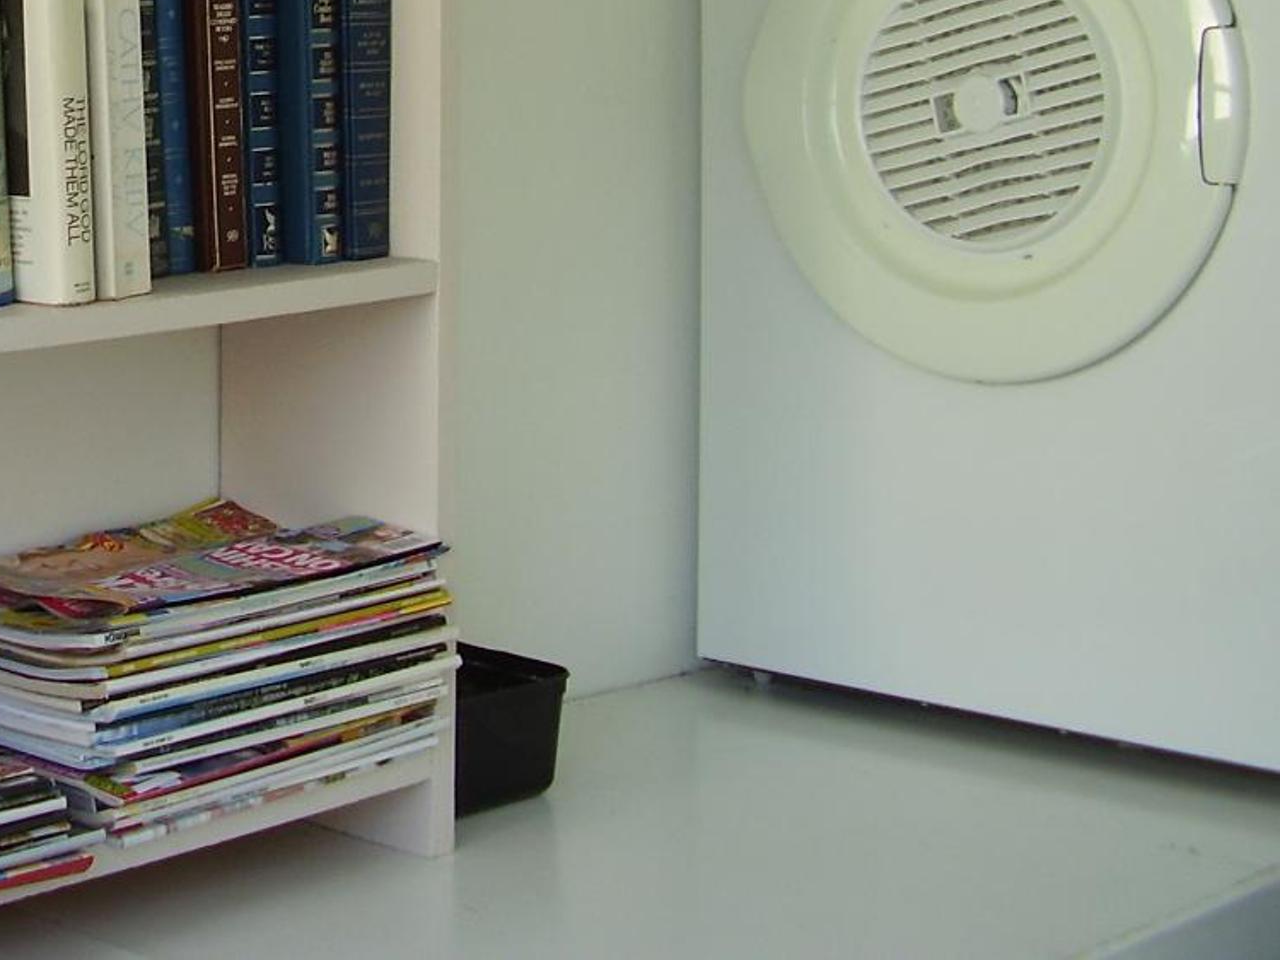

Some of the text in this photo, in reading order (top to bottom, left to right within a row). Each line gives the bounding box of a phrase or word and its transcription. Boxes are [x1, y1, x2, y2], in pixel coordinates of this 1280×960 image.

[113, 7, 146, 134] CATHY
[59, 97, 82, 247] MADE THEM ALL
[73, 97, 93, 243] THE LORD GOD
